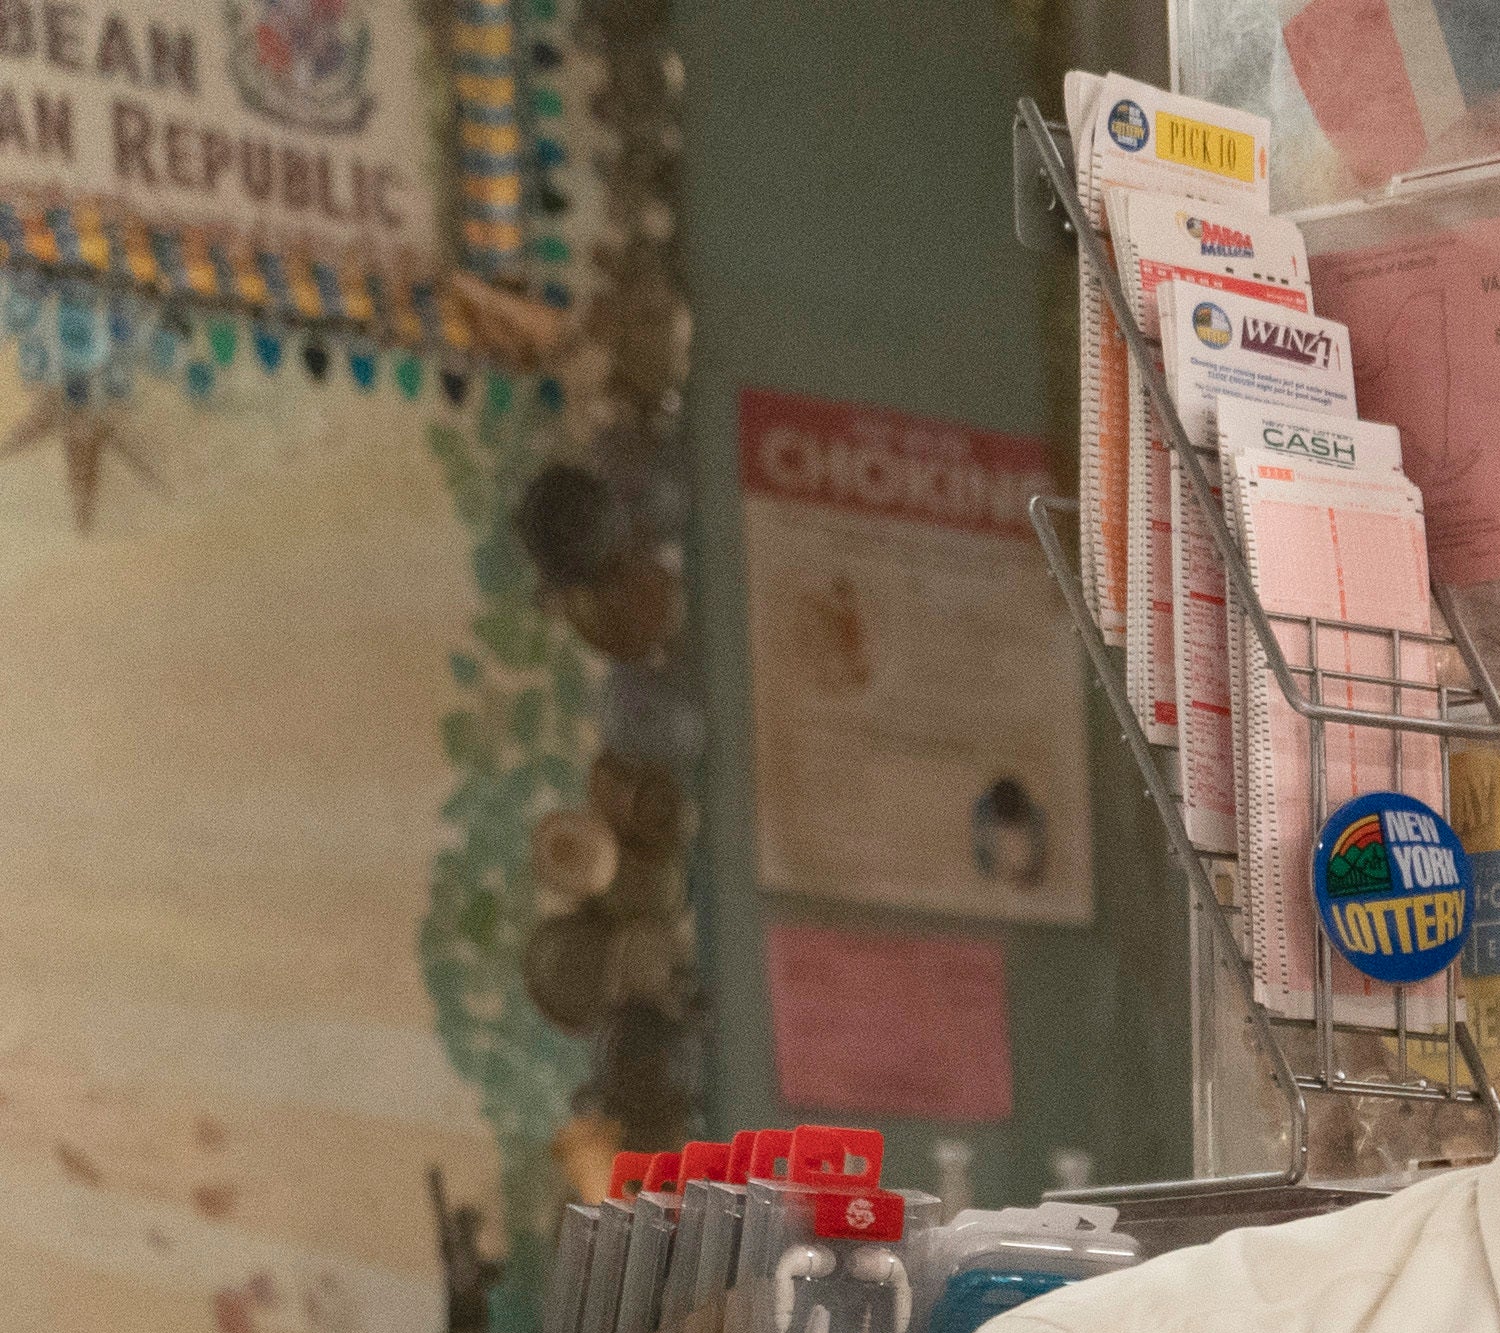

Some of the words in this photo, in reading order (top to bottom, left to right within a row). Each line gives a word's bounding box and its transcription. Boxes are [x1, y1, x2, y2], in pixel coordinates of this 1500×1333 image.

[112, 100, 402, 226] REPUBLIC
[1169, 121, 1213, 166] PICK
[1262, 427, 1356, 463] CASH
[1385, 811, 1440, 843] NEW
[1392, 845, 1460, 889] YORK
[1331, 889, 1467, 956] LOTTERY
